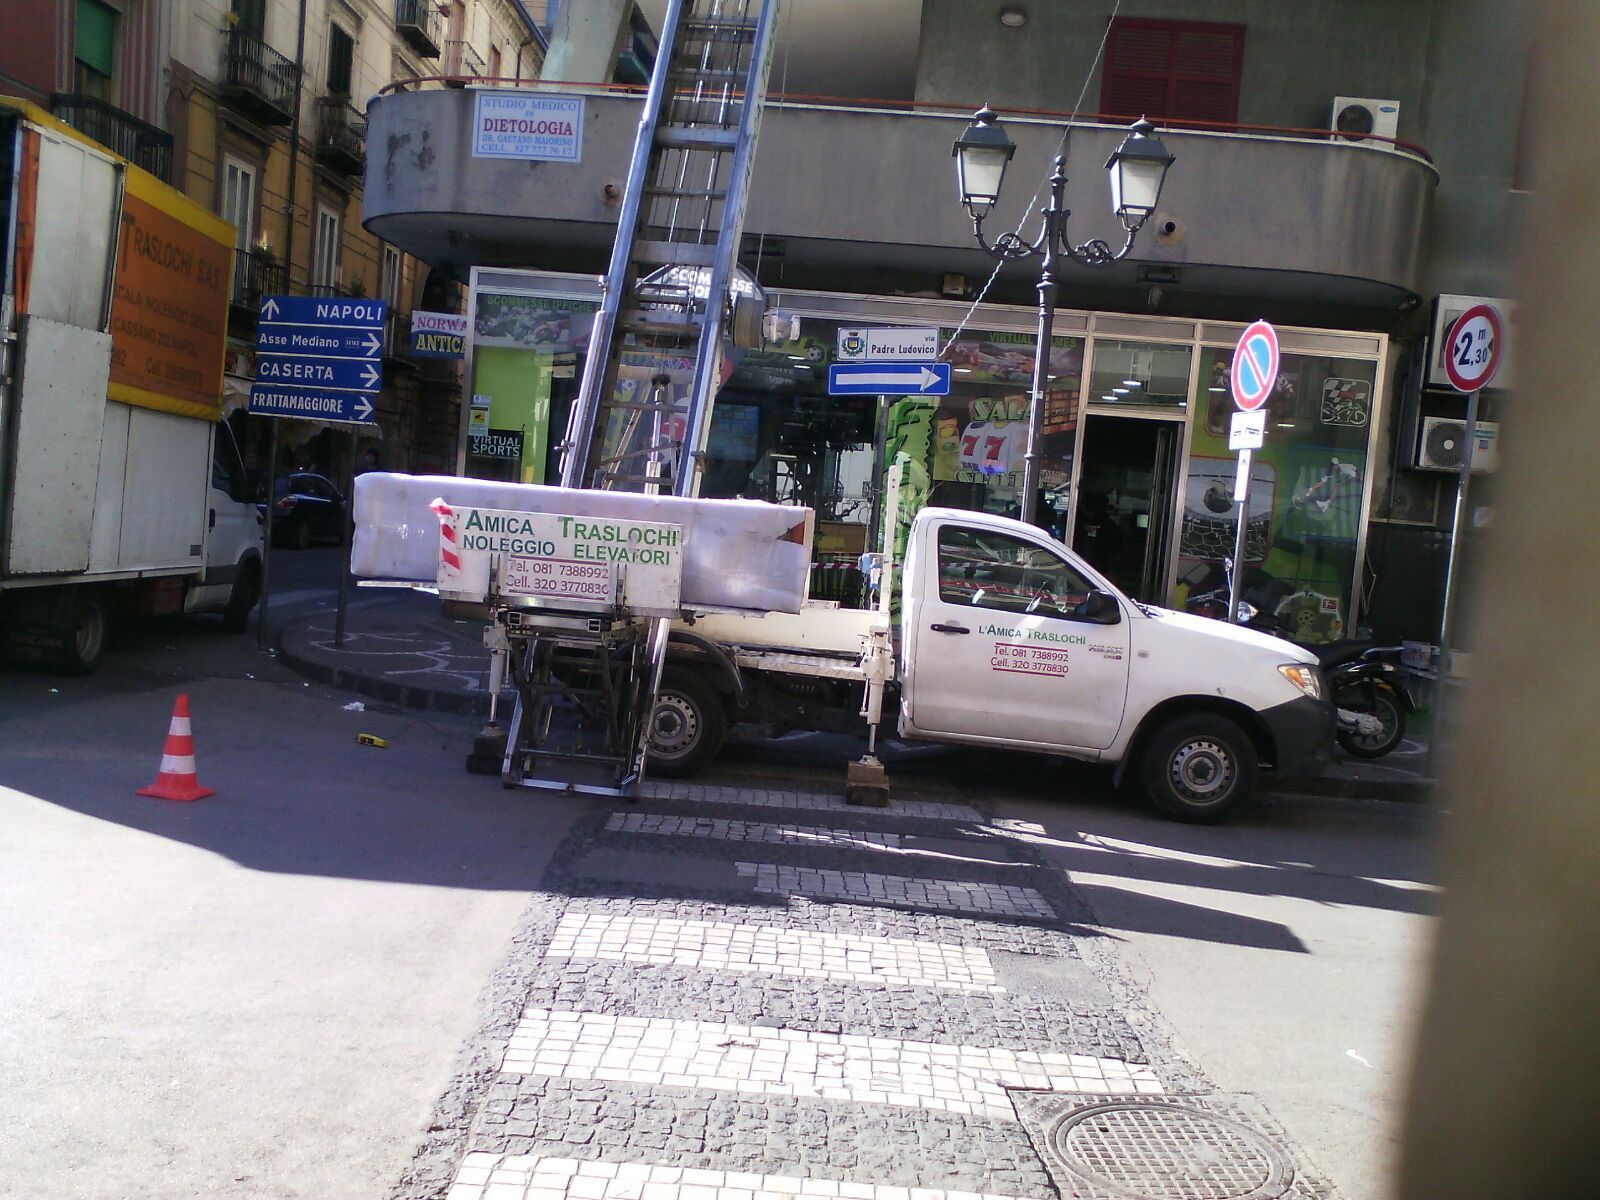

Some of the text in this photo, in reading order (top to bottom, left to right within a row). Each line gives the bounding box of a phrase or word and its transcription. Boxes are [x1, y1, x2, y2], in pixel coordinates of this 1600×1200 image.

[484, 99, 576, 111] STUDIO MEDICO
[483, 118, 573, 136] DIETOLOGIA
[316, 303, 383, 322] NAPOLI
[259, 332, 340, 349] Asse Mediano
[924, 334, 936, 343] via
[989, 331, 1033, 345] VIRTUAL
[871, 344, 935, 355] Padre Ludovico
[260, 362, 334, 381] CASERTA
[252, 391, 343, 414] FRATTAMAGGIORE
[473, 434, 521, 447] VIRTUAL
[472, 443, 520, 457] SPORTS
[560, 517, 676, 547] TRASLOCHI
[463, 534, 670, 566] NOLEGGIO ELEVATORI
[532, 562, 553, 575] 081
[559, 564, 609, 580] 7388992
[533, 578, 557, 591] 320
[1027, 628, 1087, 646] TRASLOCHI
[993, 645, 1069, 662] Tel. 081 7388992
[990, 656, 1010, 668] Cell.
[1012, 659, 1030, 670] 320
